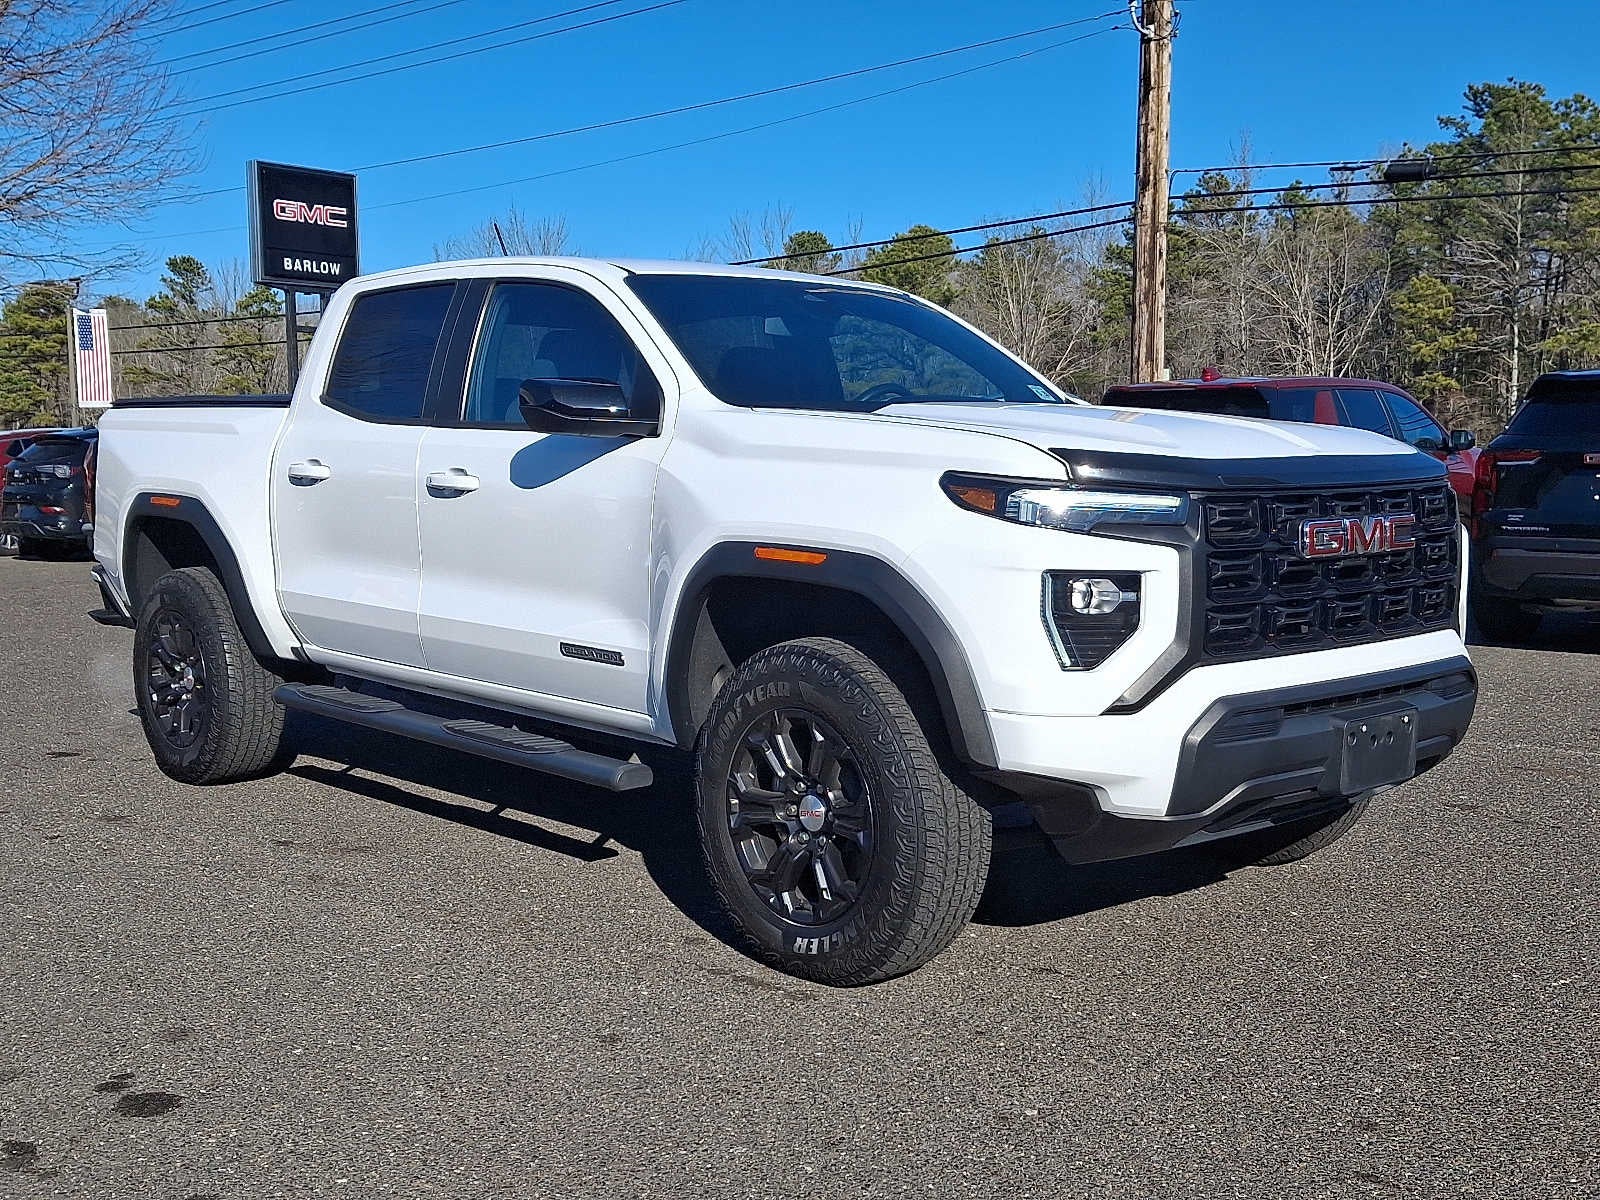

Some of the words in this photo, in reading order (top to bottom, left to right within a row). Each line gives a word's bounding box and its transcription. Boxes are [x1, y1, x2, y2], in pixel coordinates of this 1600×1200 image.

[273, 199, 347, 228] GMC
[283, 257, 341, 275] BARLOW
[1299, 513, 1415, 558] GMC
[800, 810, 823, 818] GMC
